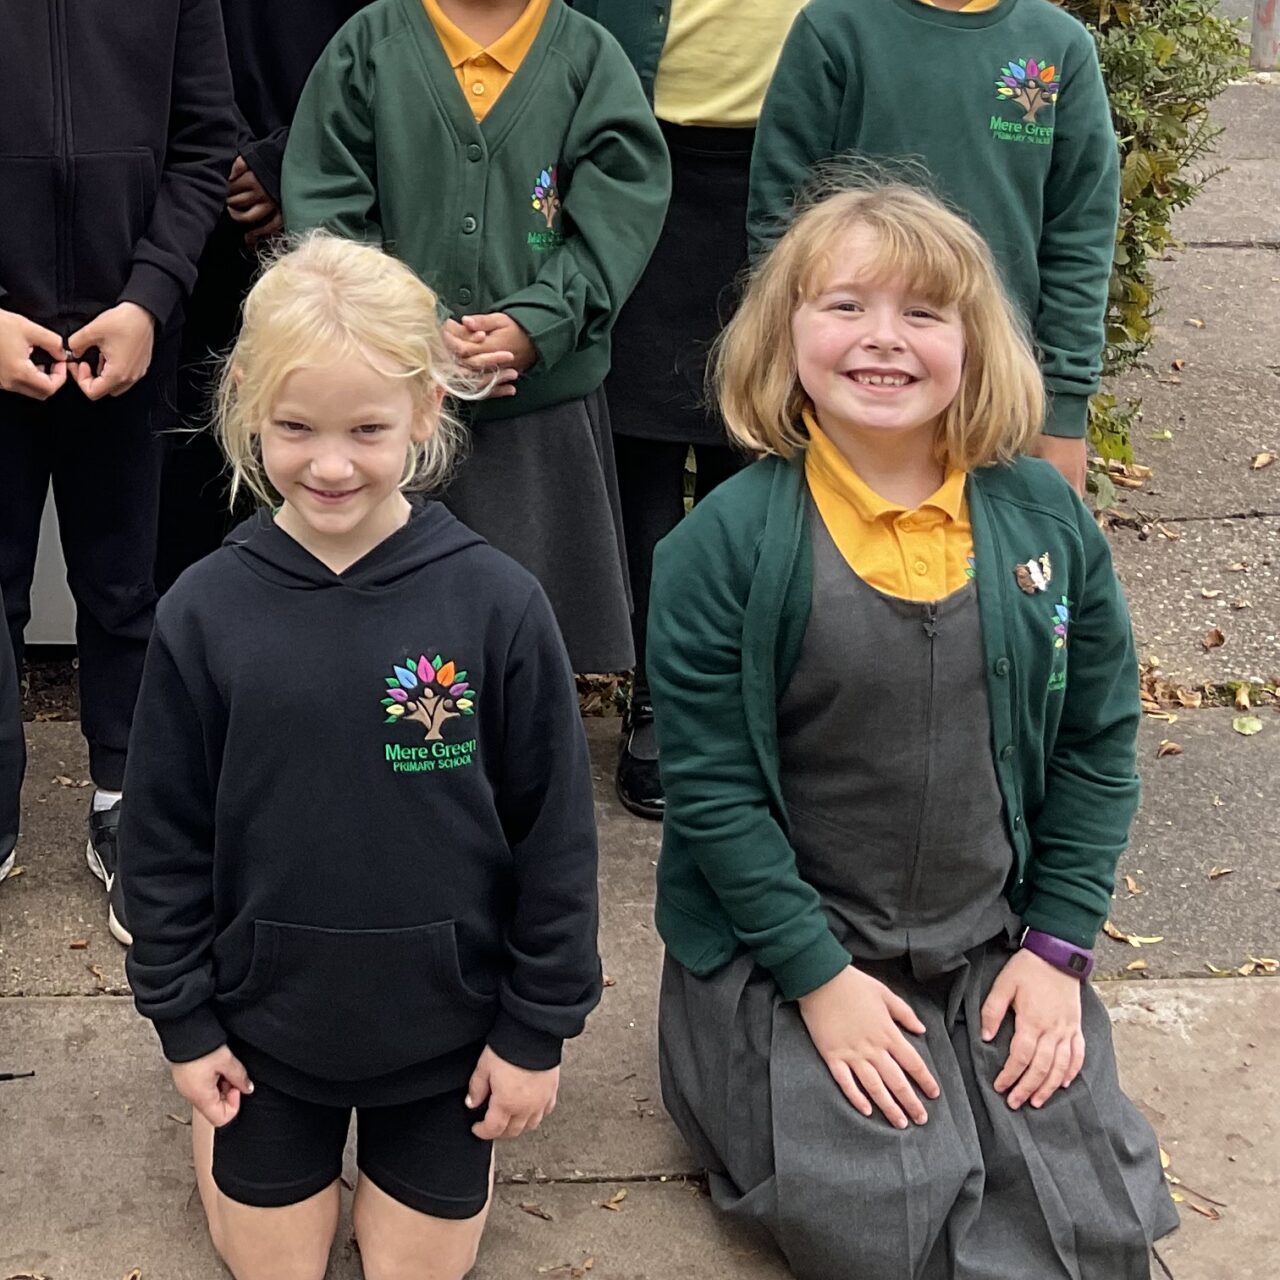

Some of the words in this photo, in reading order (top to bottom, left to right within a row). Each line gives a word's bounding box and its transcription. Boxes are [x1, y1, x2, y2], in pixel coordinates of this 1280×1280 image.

[990, 116, 1022, 132] Mere
[1025, 123, 1054, 136] Gree
[385, 744, 428, 761] Mere
[432, 739, 477, 757] Green
[393, 761, 436, 772] PRIMARY
